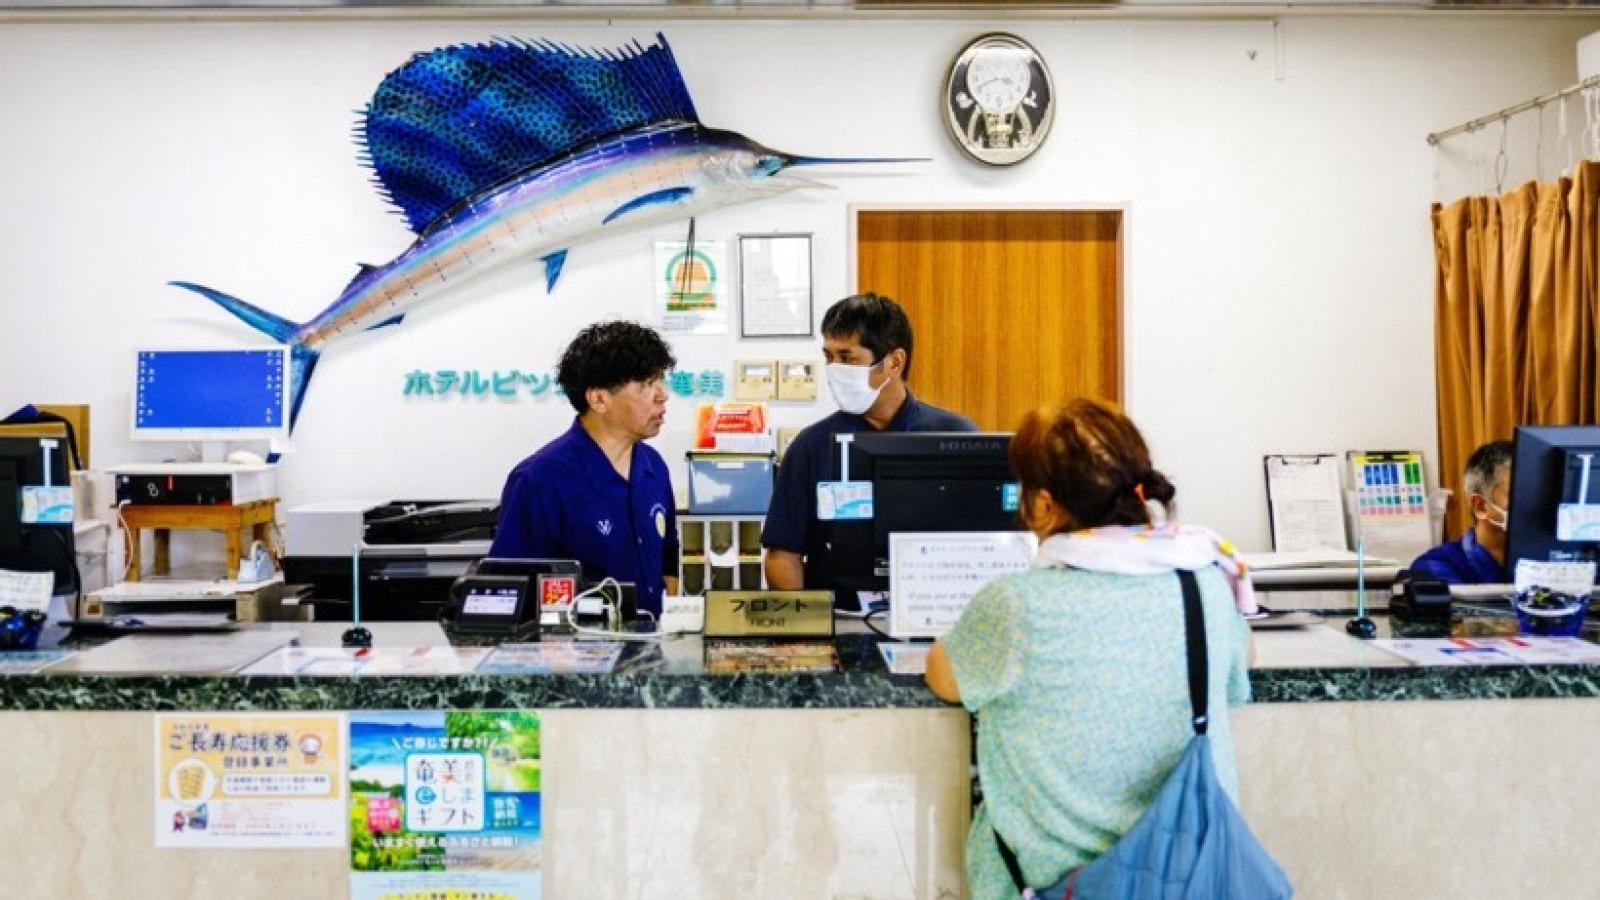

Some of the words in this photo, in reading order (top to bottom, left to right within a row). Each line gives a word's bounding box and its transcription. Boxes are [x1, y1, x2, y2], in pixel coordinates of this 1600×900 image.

[404, 369, 566, 396] ホテルビッ
[730, 598, 808, 613] フロント
[170, 732, 290, 752] ご長寿応援券
[415, 809, 475, 825] ギフト
